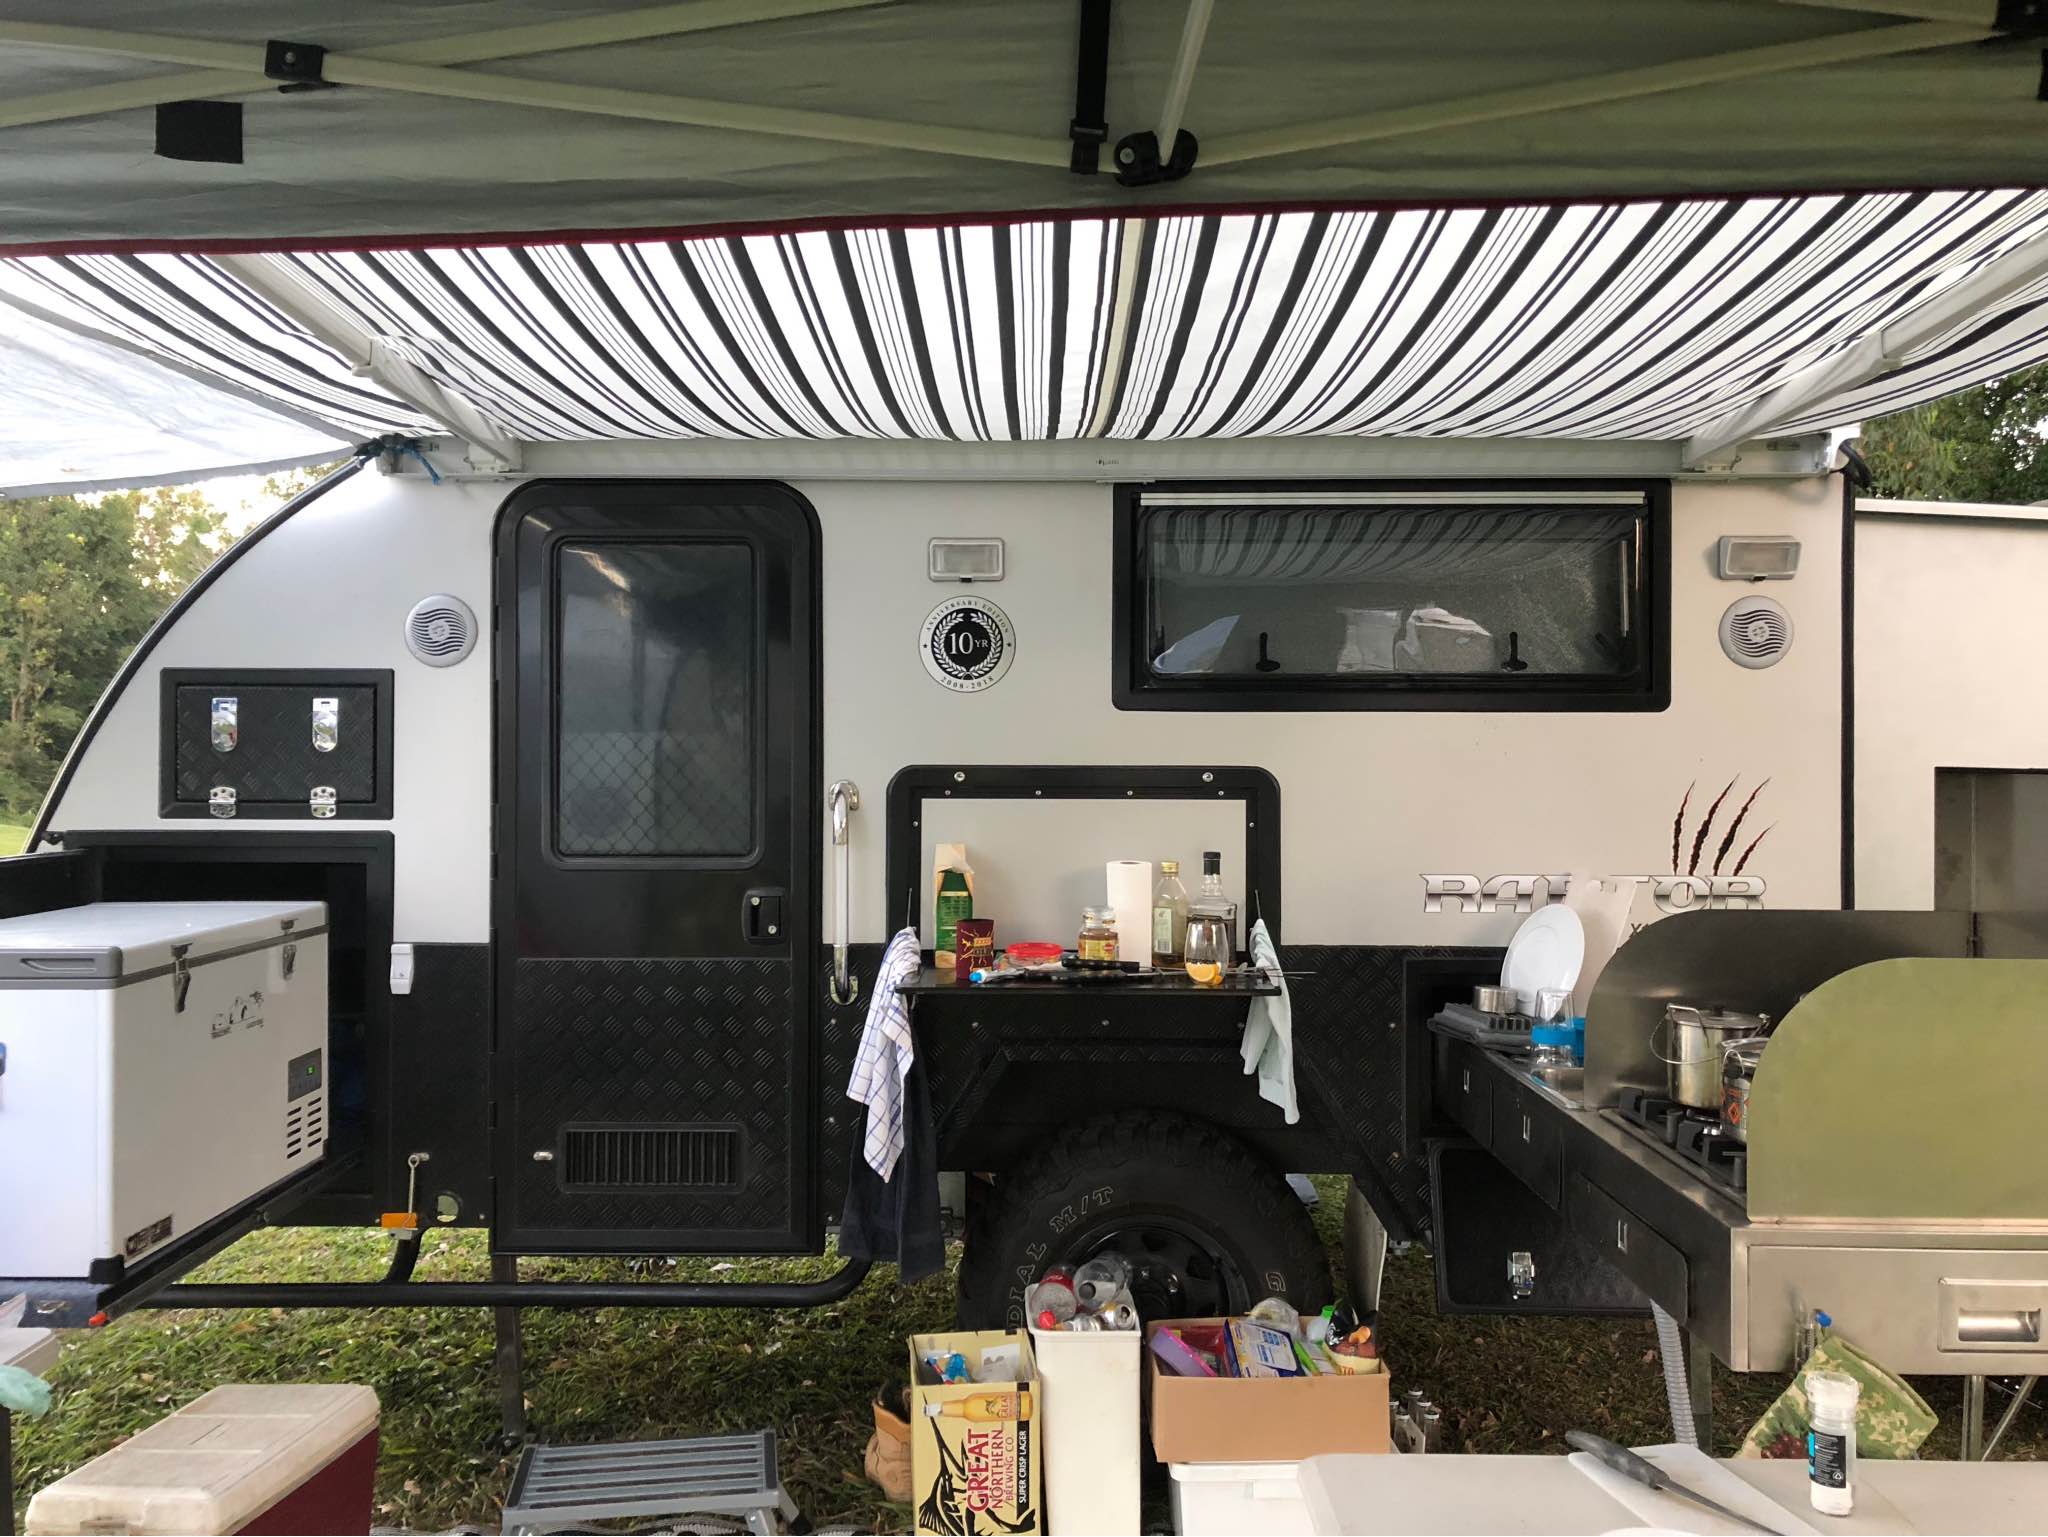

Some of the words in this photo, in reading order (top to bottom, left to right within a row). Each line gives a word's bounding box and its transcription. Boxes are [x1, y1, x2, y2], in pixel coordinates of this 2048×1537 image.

[982, 604, 1009, 633] EDITION
[949, 632, 974, 655] 10
[974, 639, 989, 648] YR
[1050, 1187, 1114, 1233] M/T
[1005, 1437, 1014, 1452] CO
[1018, 1431, 1027, 1455] LAGER
[967, 1428, 989, 1511] GREAT
[992, 1430, 1003, 1508] NORTHERN
[1005, 1456, 1014, 1500] BREWING
[1018, 1456, 1027, 1478] CRISP
[1018, 1480, 1027, 1504] SUPER
